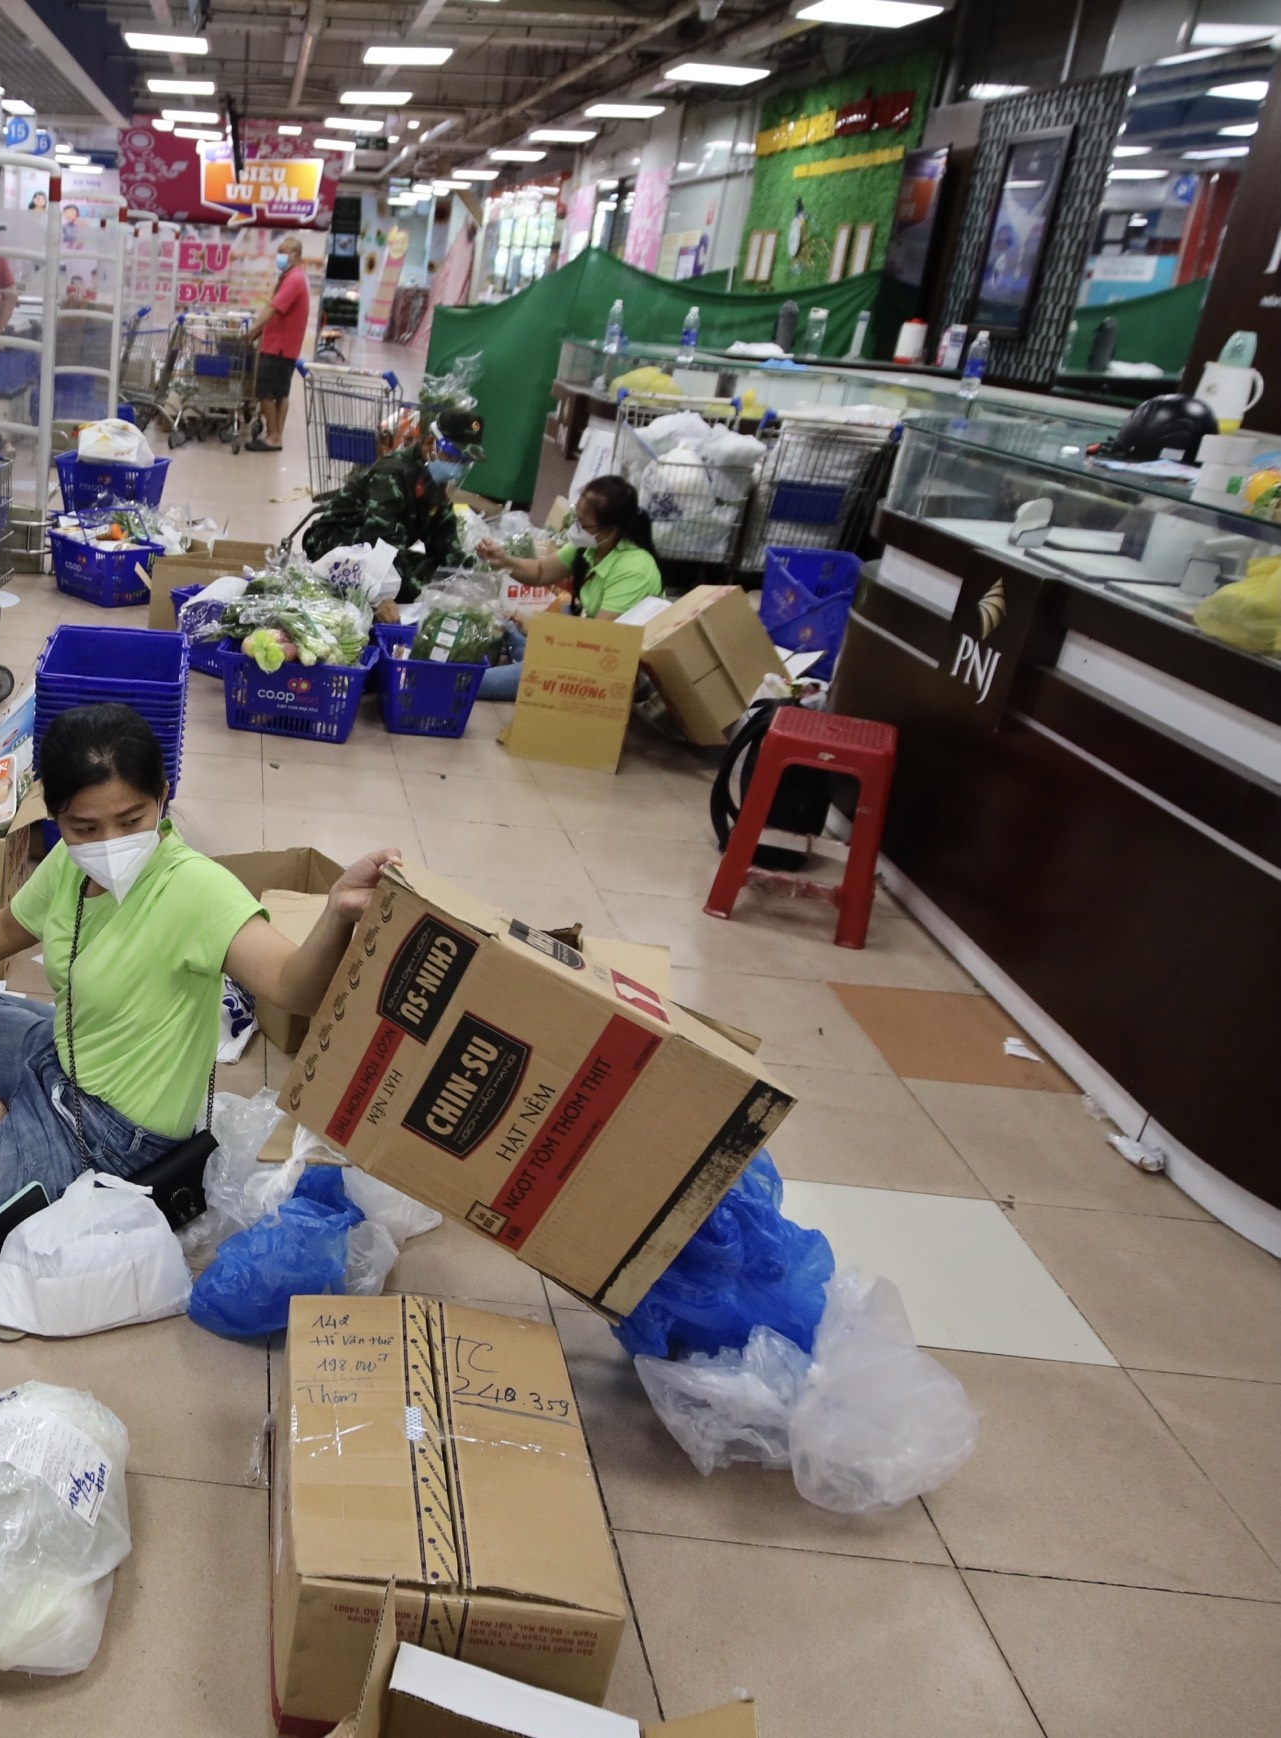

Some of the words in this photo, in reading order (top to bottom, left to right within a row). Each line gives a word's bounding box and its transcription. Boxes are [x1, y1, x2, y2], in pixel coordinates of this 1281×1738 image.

[8, 123, 26, 138] 15
[950, 633, 1002, 704] PNJ
[397, 933, 461, 1025] CHIN-SU
[365, 1095, 390, 1126] NÊM
[422, 1035, 501, 1139] CHIN-SU
[495, 1123, 533, 1162] HẠT
[516, 1080, 556, 1125] NÊM
[502, 1170, 539, 1212] NGỌT
[527, 1135, 561, 1172] TÔM
[551, 1092, 591, 1139] THƠM
[582, 1056, 615, 1094] THỊT
[471, 1619, 491, 1628] Nam
